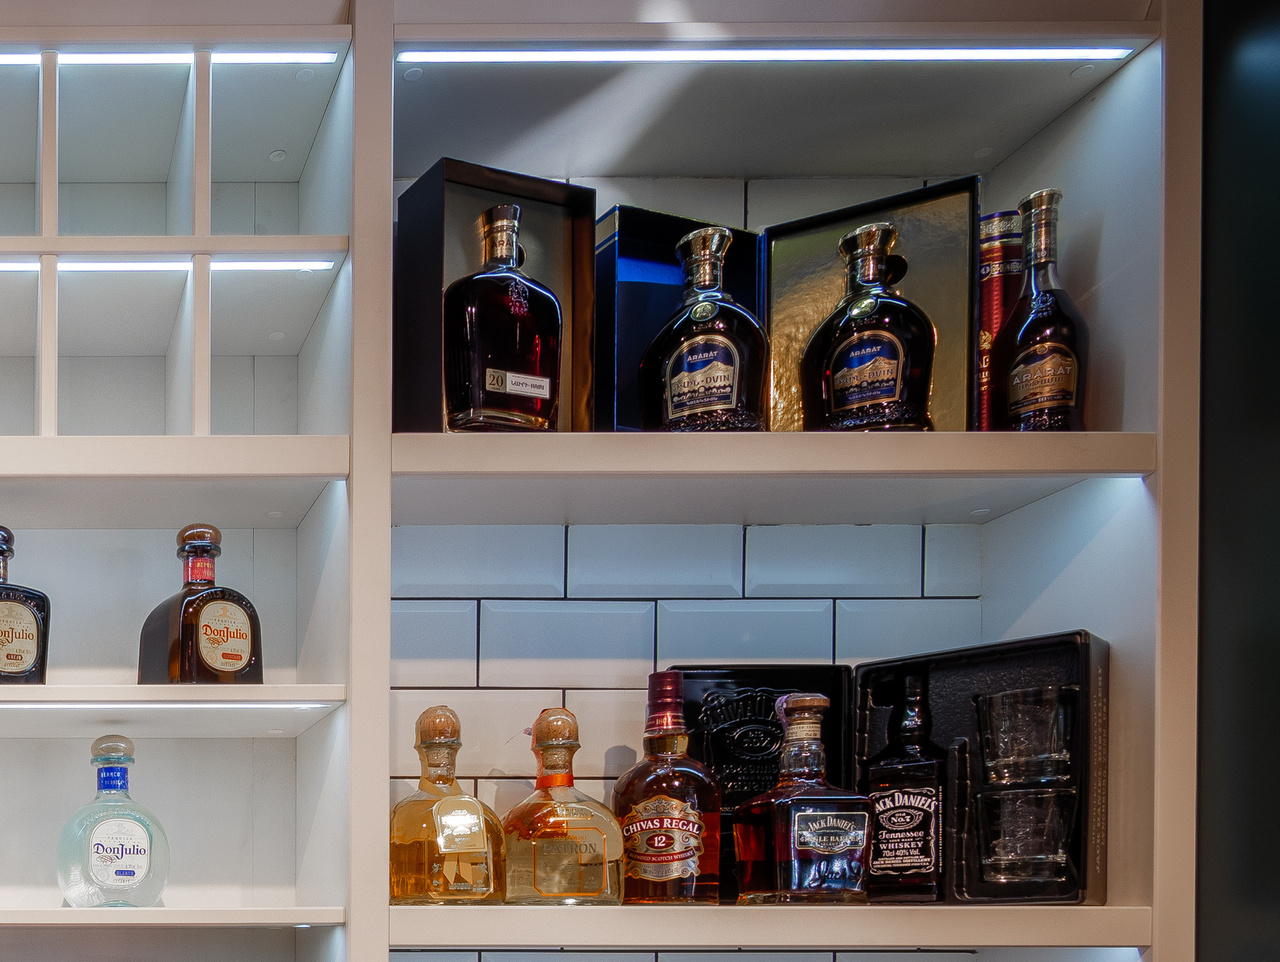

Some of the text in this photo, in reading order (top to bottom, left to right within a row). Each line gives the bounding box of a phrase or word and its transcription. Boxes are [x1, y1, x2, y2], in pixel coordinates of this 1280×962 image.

[687, 351, 718, 361] ARARAT
[850, 346, 881, 357] ARARAT
[489, 374, 503, 387] 20
[706, 373, 730, 384] DVIN
[1013, 365, 1072, 385] ARARAT
[875, 793, 938, 814] ACK DANIEL'S
[623, 818, 700, 836] CHIVAS REGAL
[808, 816, 856, 832] JACK DANIEL'S
[878, 831, 925, 839] Tennessee
[654, 836, 666, 846] 12
[879, 841, 923, 849] WHISKEY
[629, 850, 694, 862] BLENDED SCOTCH WHISKY
